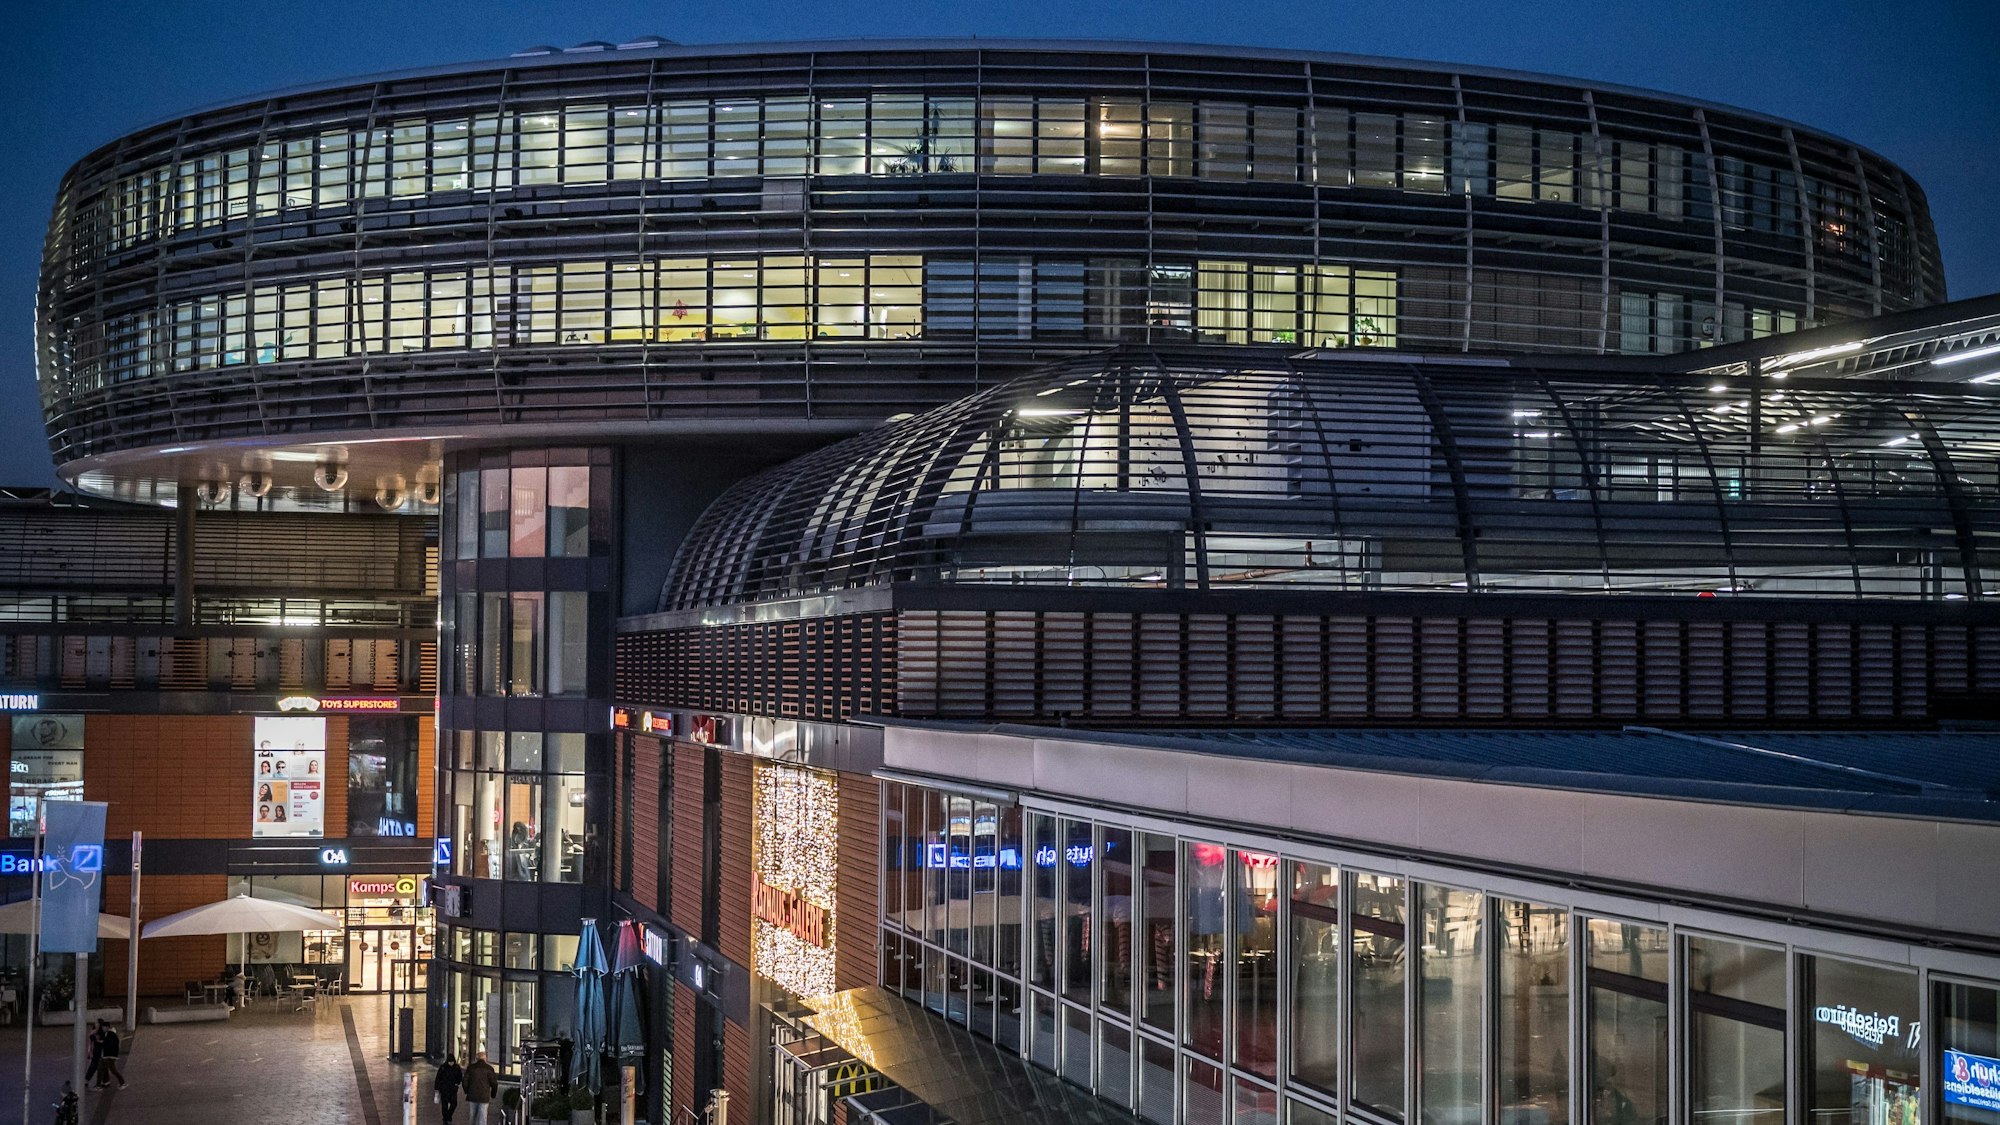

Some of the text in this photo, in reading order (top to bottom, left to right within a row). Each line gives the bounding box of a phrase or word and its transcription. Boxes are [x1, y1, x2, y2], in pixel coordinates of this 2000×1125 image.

[322, 700, 342, 709] TOYS
[343, 700, 397, 709] SUPERSTORES
[1, 855, 57, 873] Bank
[351, 881, 395, 894] Kamps
